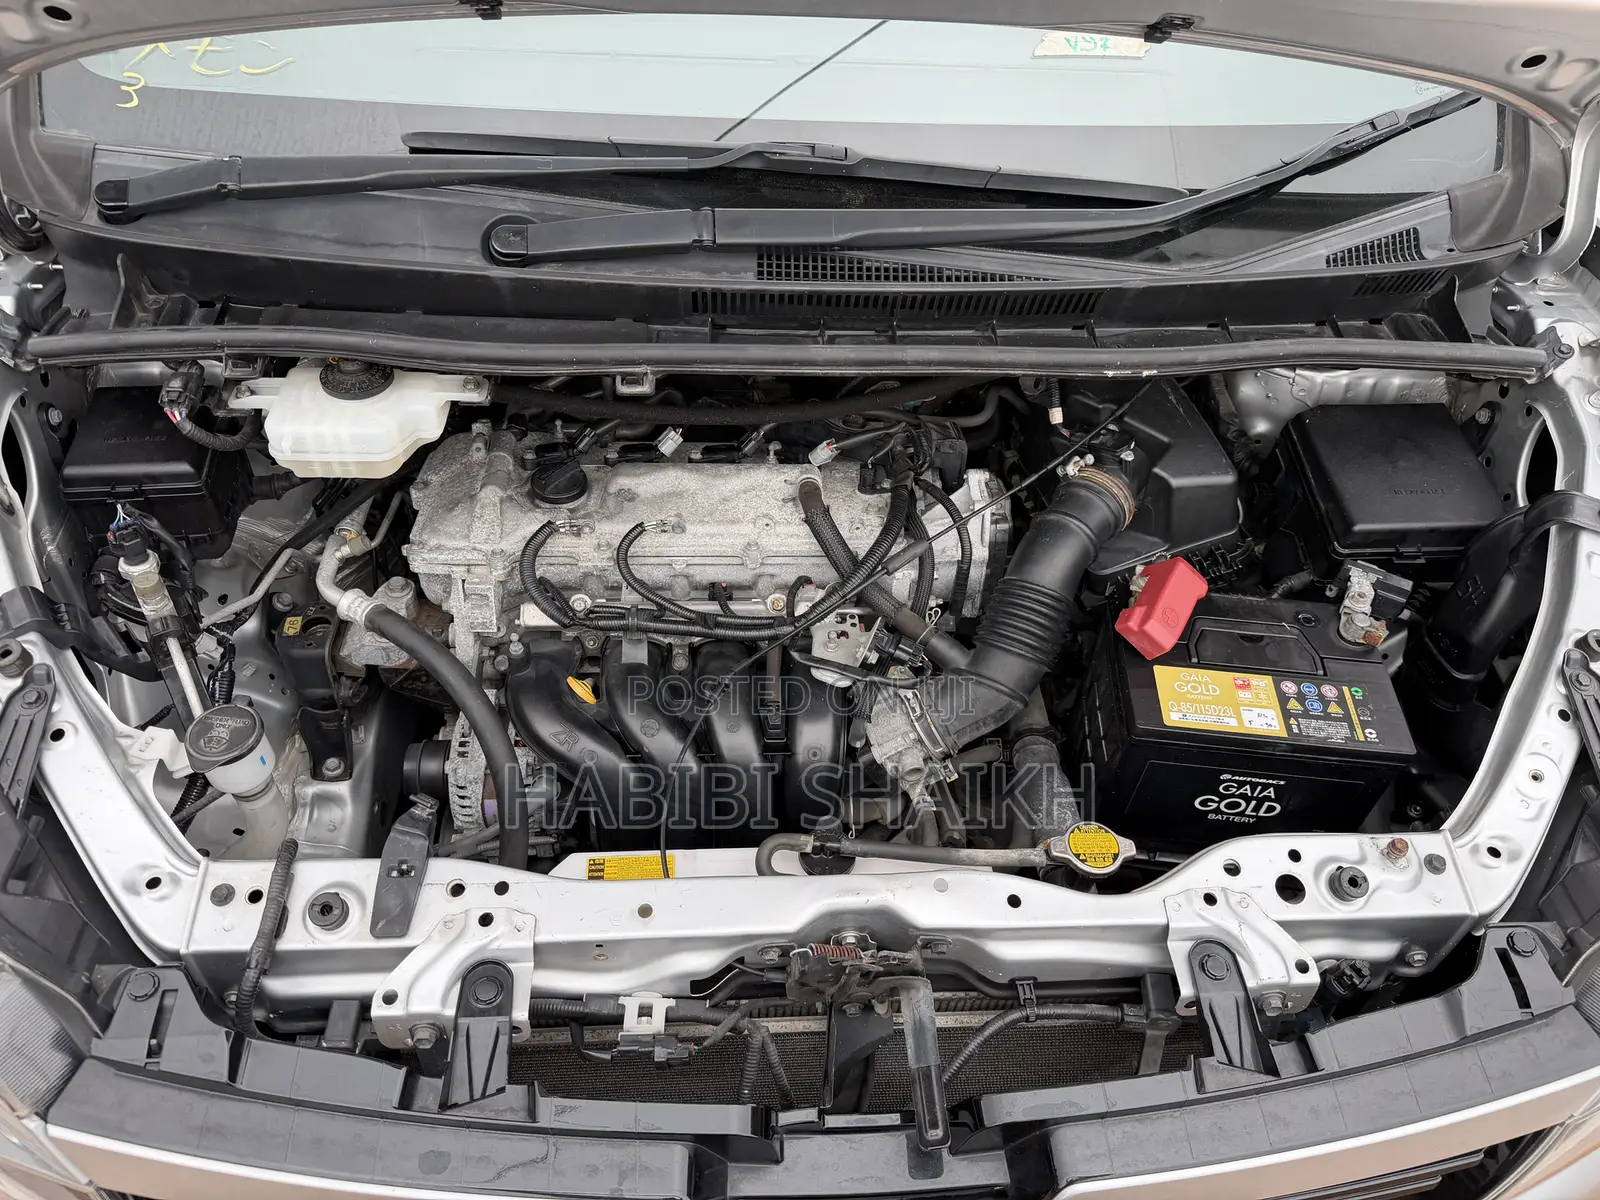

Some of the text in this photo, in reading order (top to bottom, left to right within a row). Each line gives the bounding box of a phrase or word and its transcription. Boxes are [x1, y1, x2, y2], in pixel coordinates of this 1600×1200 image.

[1180, 672, 1212, 683] GAIA
[1174, 681, 1220, 696] GOLD
[1218, 782, 1276, 799] GAIA
[1194, 795, 1282, 817] GOLD
[1207, 813, 1257, 823] BATTERY
